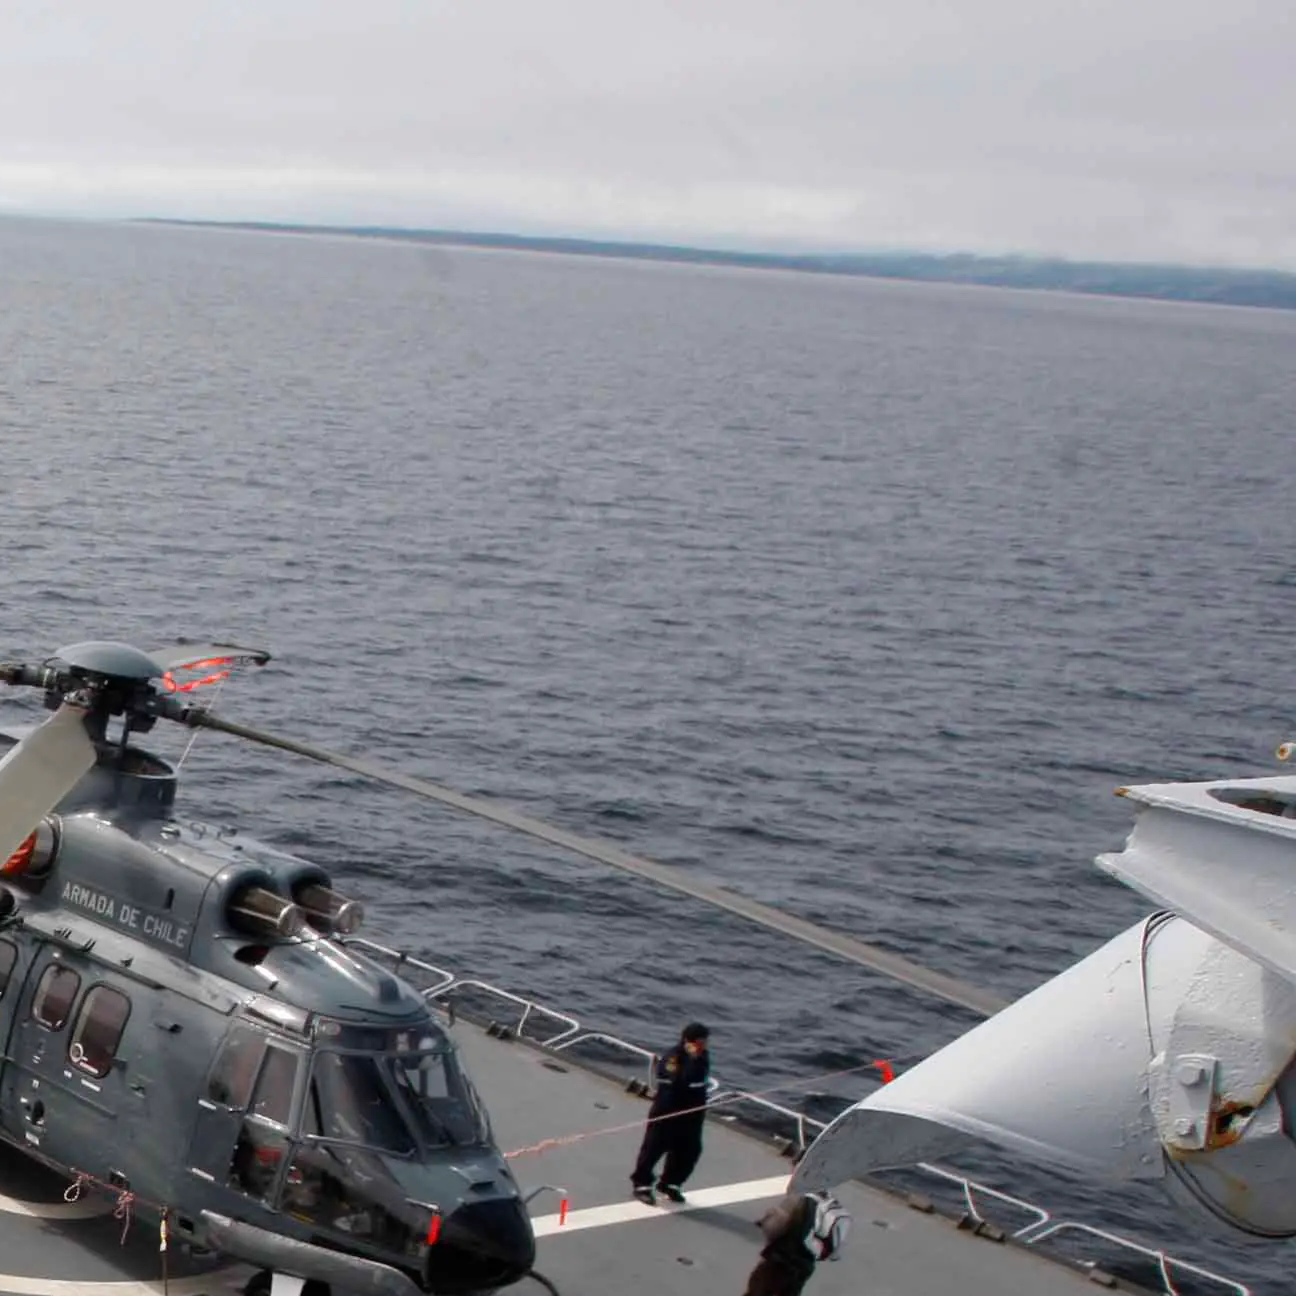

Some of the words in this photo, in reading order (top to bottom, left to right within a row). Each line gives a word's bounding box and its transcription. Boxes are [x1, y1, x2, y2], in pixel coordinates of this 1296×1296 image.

[61, 881, 115, 918] ARMADA
[119, 903, 141, 928] DE
[143, 915, 189, 948] CHILE
